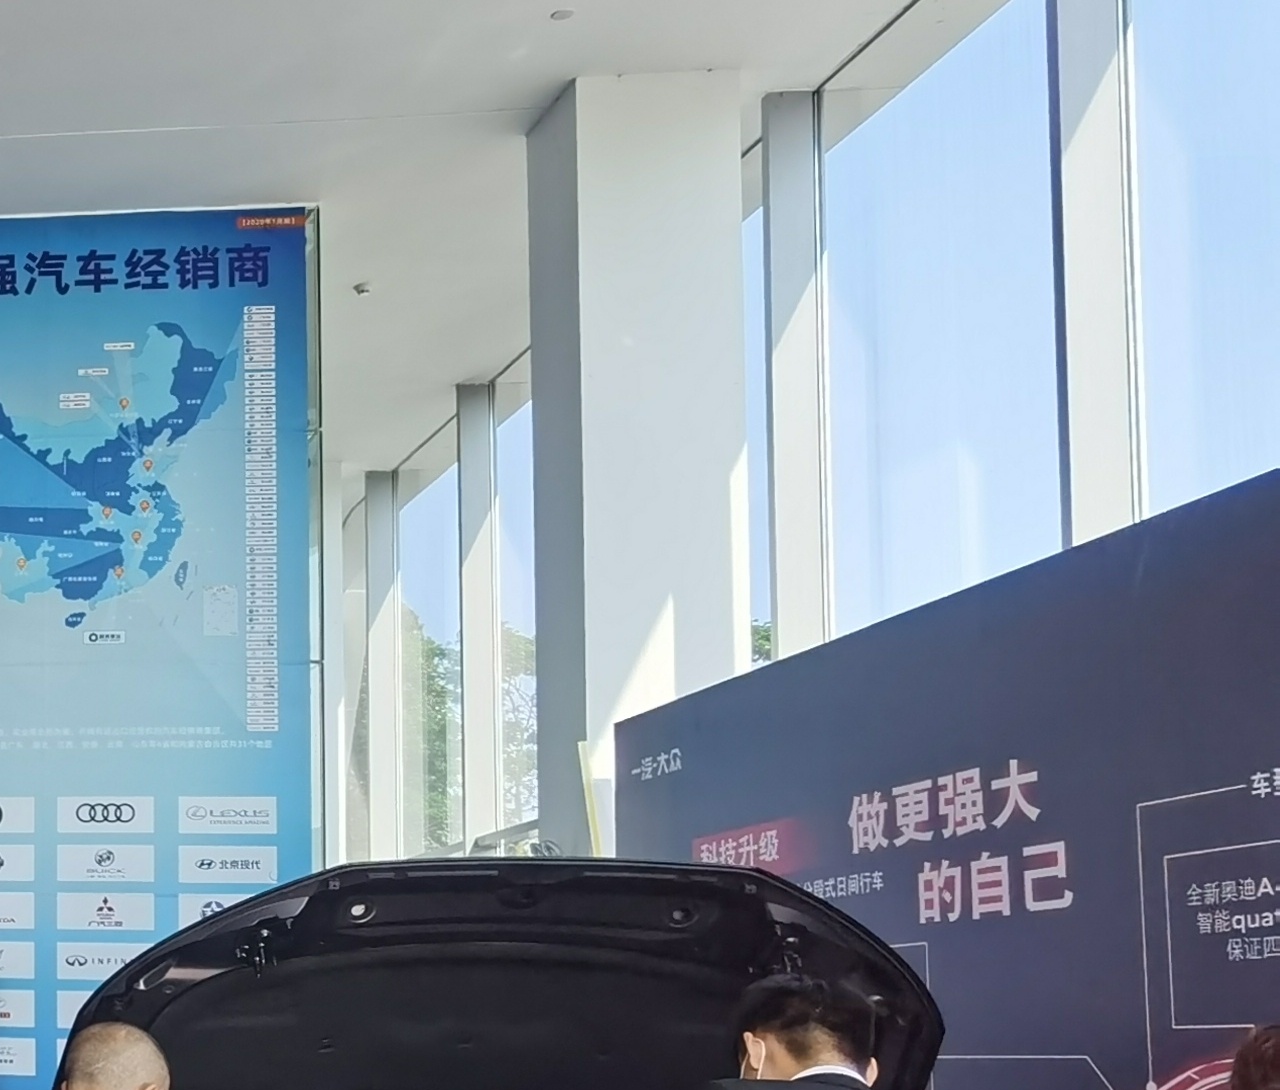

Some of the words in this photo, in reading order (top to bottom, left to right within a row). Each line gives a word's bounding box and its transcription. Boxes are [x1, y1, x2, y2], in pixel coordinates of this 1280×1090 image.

[209, 810, 269, 818] LEXUS
[848, 759, 1041, 854] 做更强大
[700, 829, 780, 866] 科技升级
[219, 859, 261, 870] 北京现代
[918, 840, 1074, 924] 的自己
[1187, 877, 1280, 906] 全新奥迪A
